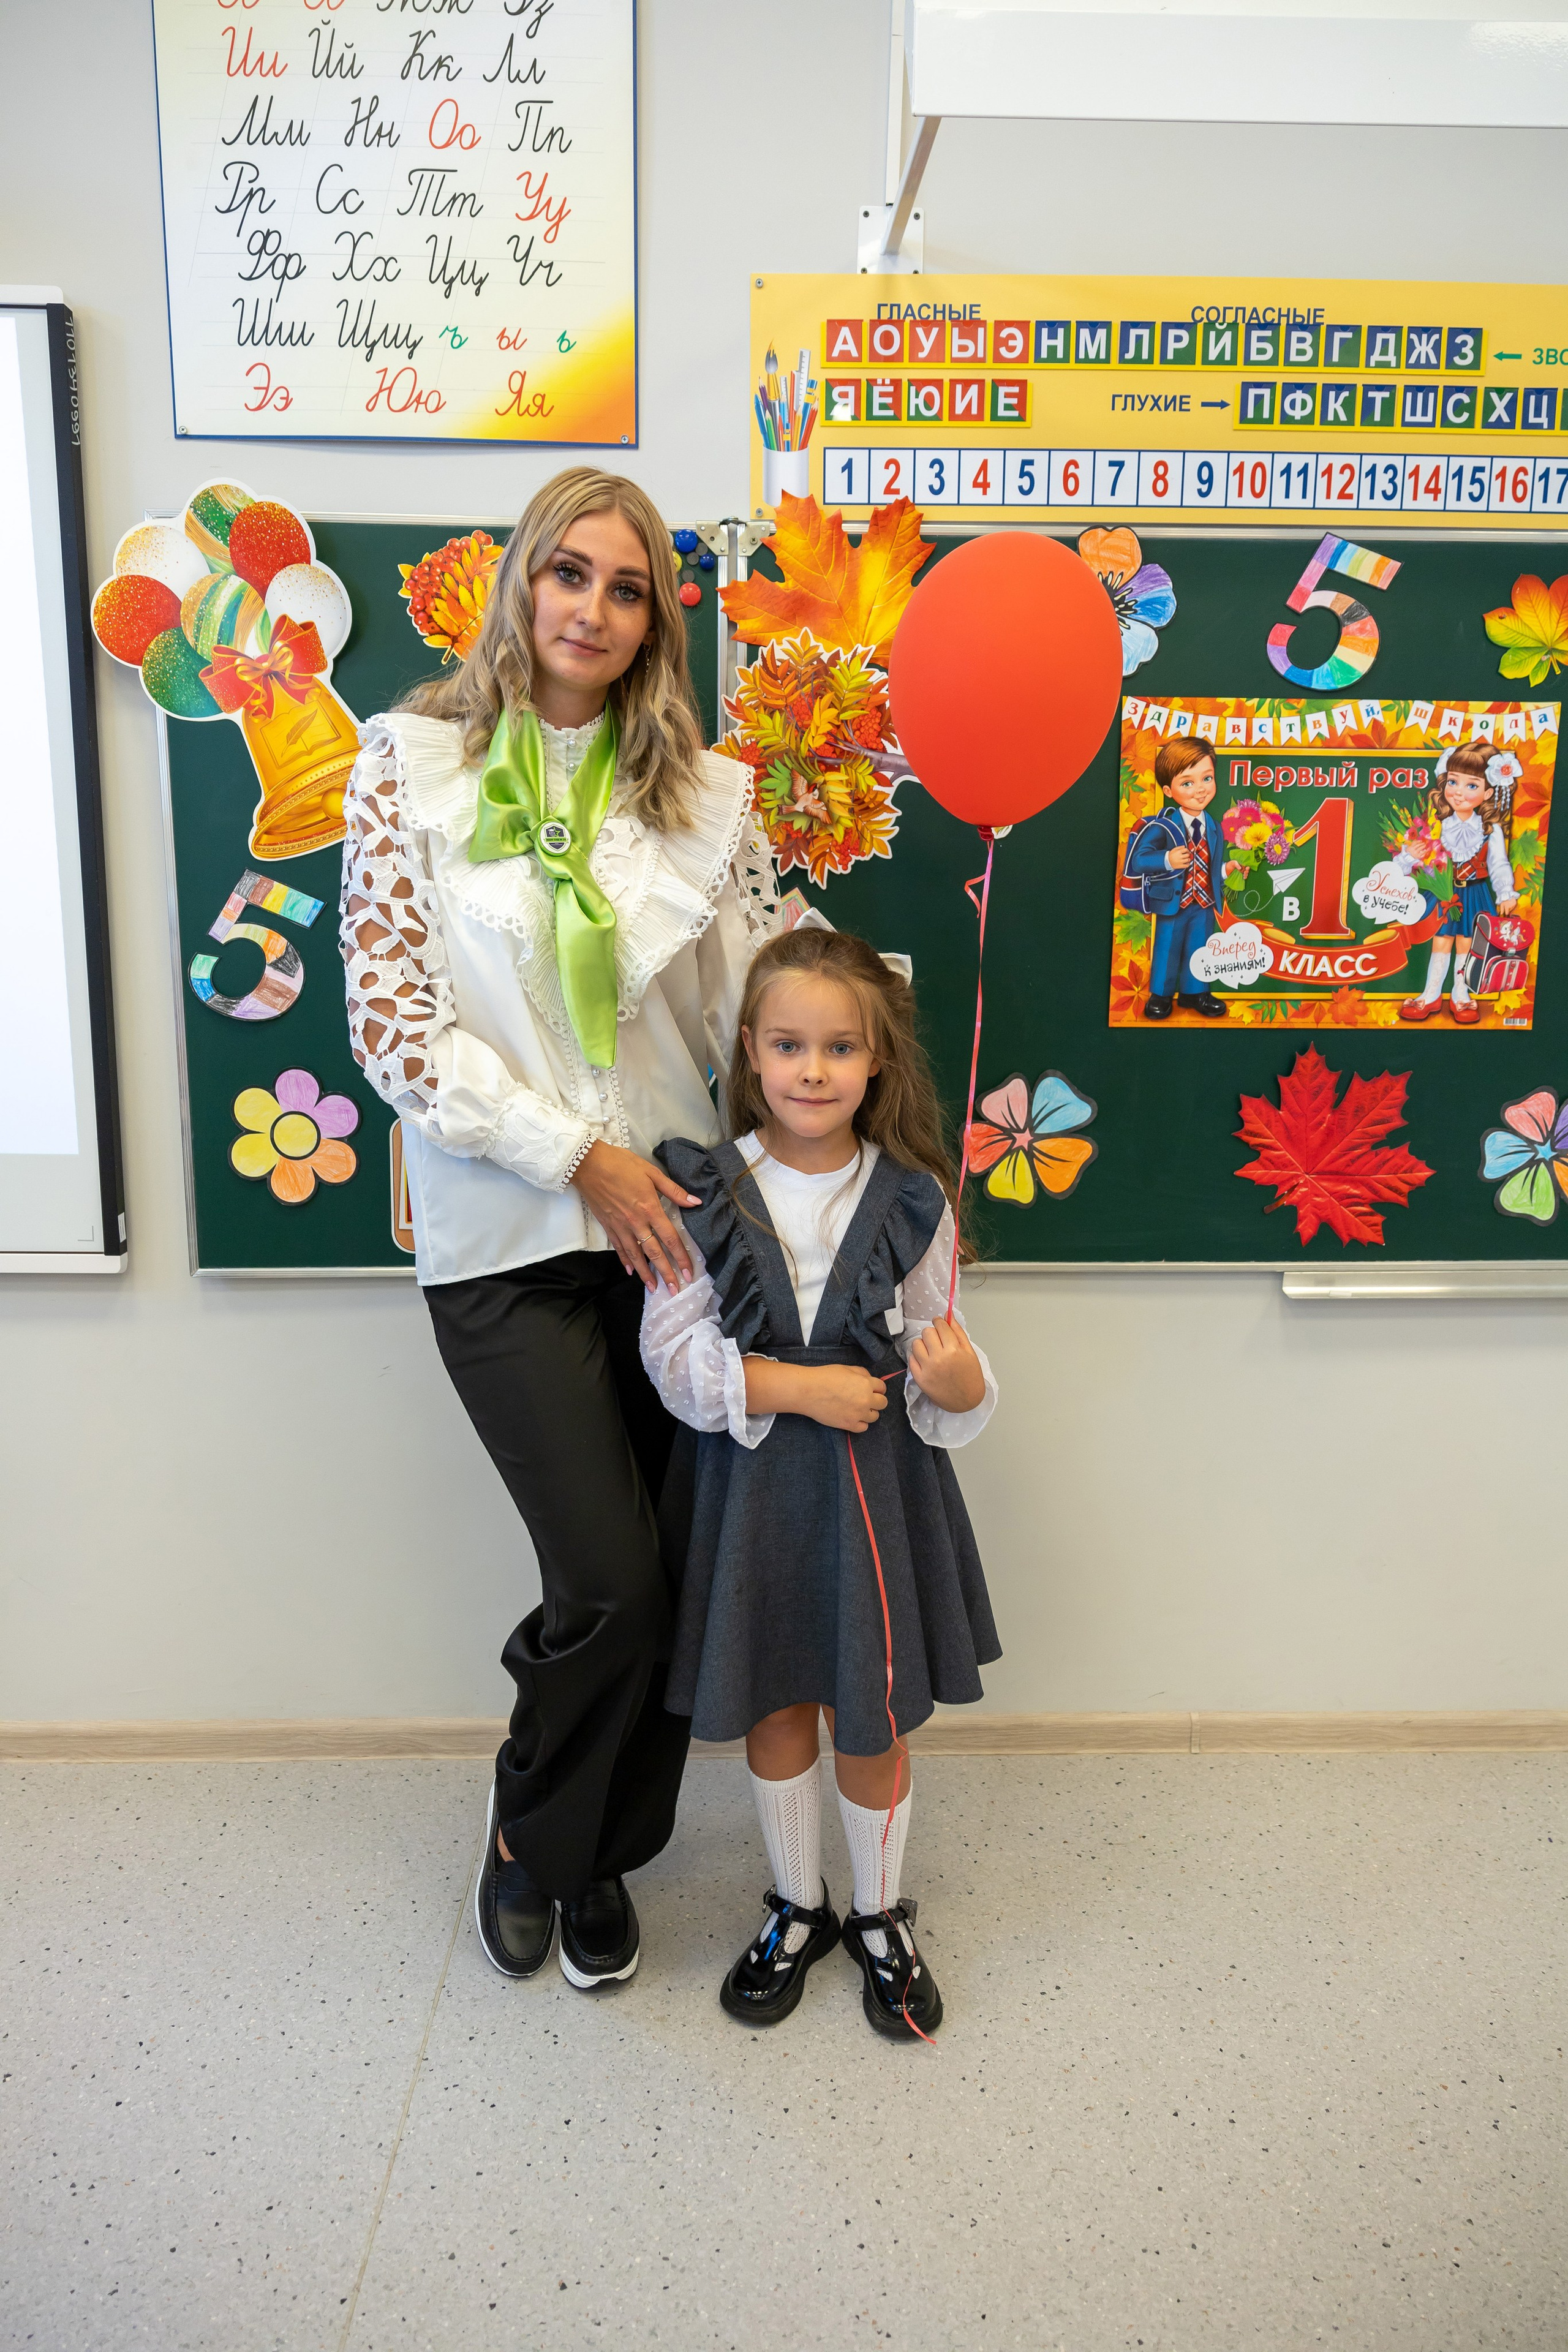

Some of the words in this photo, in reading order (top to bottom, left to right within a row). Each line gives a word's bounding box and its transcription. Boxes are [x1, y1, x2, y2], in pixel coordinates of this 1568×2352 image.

[221, 26, 288, 78] Ии
[307, 19, 364, 80] Йй
[399, 29, 464, 83] Кк
[482, 32, 546, 85] Лл
[221, 94, 311, 148] Мм
[343, 94, 401, 149] Нн
[428, 98, 482, 151] Оо
[508, 100, 573, 153] Пп
[214, 160, 277, 237] Рр
[315, 163, 365, 215] Сс
[396, 168, 484, 218] Тт
[514, 170, 572, 243] Уу
[238, 228, 307, 303] Фф
[331, 231, 402, 282] Хх
[425, 234, 490, 299] Цц
[506, 235, 563, 287] Чч
[232, 297, 315, 347] Шш
[336, 298, 424, 362] Щщ
[438, 325, 469, 350] ъ
[496, 326, 527, 350] ы
[556, 329, 578, 353] ь
[877, 303, 981, 321] ГЛАСНЫЕ
[1191, 306, 1325, 325] СОГЛАСНЫЕ
[244, 362, 294, 412] Ээ
[364, 366, 447, 414] Юю
[494, 370, 554, 418] Яя
[1111, 394, 1191, 412] ГЛУХИЕ
[841, 458, 853, 494] 1
[883, 458, 900, 495] 2
[929, 458, 945, 496] 3
[972, 459, 990, 496] 4
[1018, 459, 1035, 496] 5
[1063, 459, 1080, 496] 6
[1108, 460, 1125, 496] 7
[1152, 460, 1169, 497] 8
[1197, 461, 1213, 498] 9
[1232, 461, 1267, 499] 10
[1280, 462, 1309, 499] 11
[1321, 463, 1355, 500] 12
[1365, 464, 1398, 501] 13
[1408, 464, 1442, 501] 14
[1451, 466, 1486, 502] 15
[1494, 466, 1529, 503] 16
[1538, 467, 1568, 503] 17
[1267, 532, 1403, 692] 5
[1229, 760, 1358, 793] Первый
[1369, 767, 1429, 794] раз
[1293, 797, 1355, 940] 1
[1366, 870, 1415, 901] Успехов
[188, 869, 327, 1021] 5
[1208, 938, 1256, 960] Вперед
[1214, 957, 1266, 974] знаниям!
[1278, 950, 1379, 978] КЛАСС
